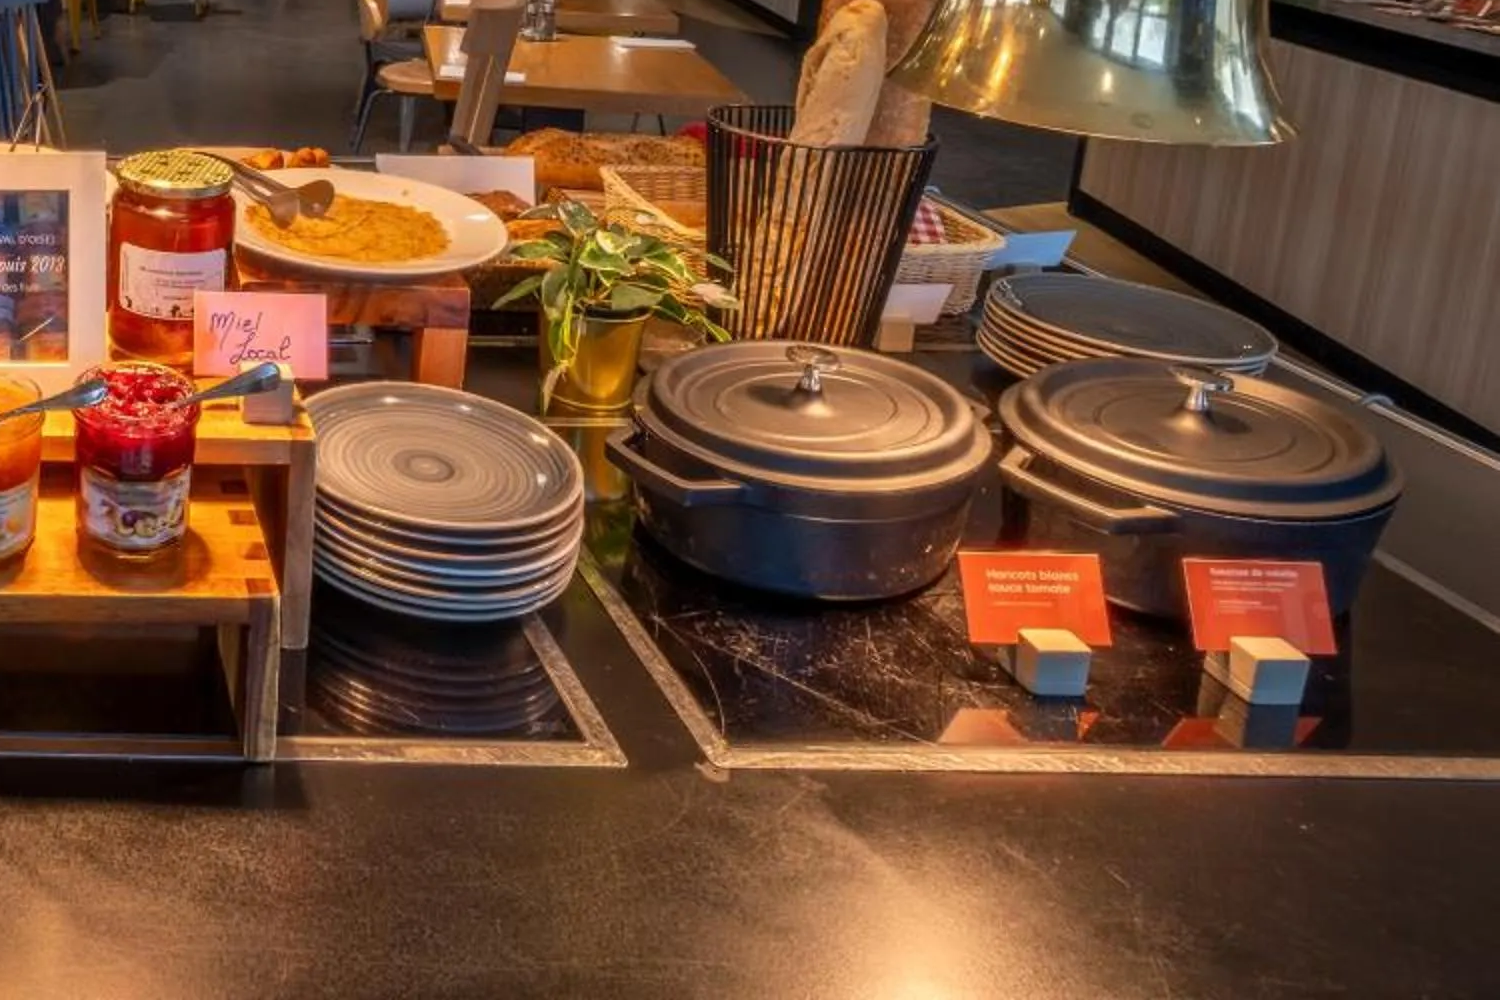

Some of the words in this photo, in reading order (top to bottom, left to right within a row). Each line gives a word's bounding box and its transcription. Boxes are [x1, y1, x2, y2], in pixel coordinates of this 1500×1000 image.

[30, 255, 66, 273] 2013
[210, 310, 263, 351] Miel
[229, 331, 293, 365] Local
[1025, 584, 1071, 595] tomate
